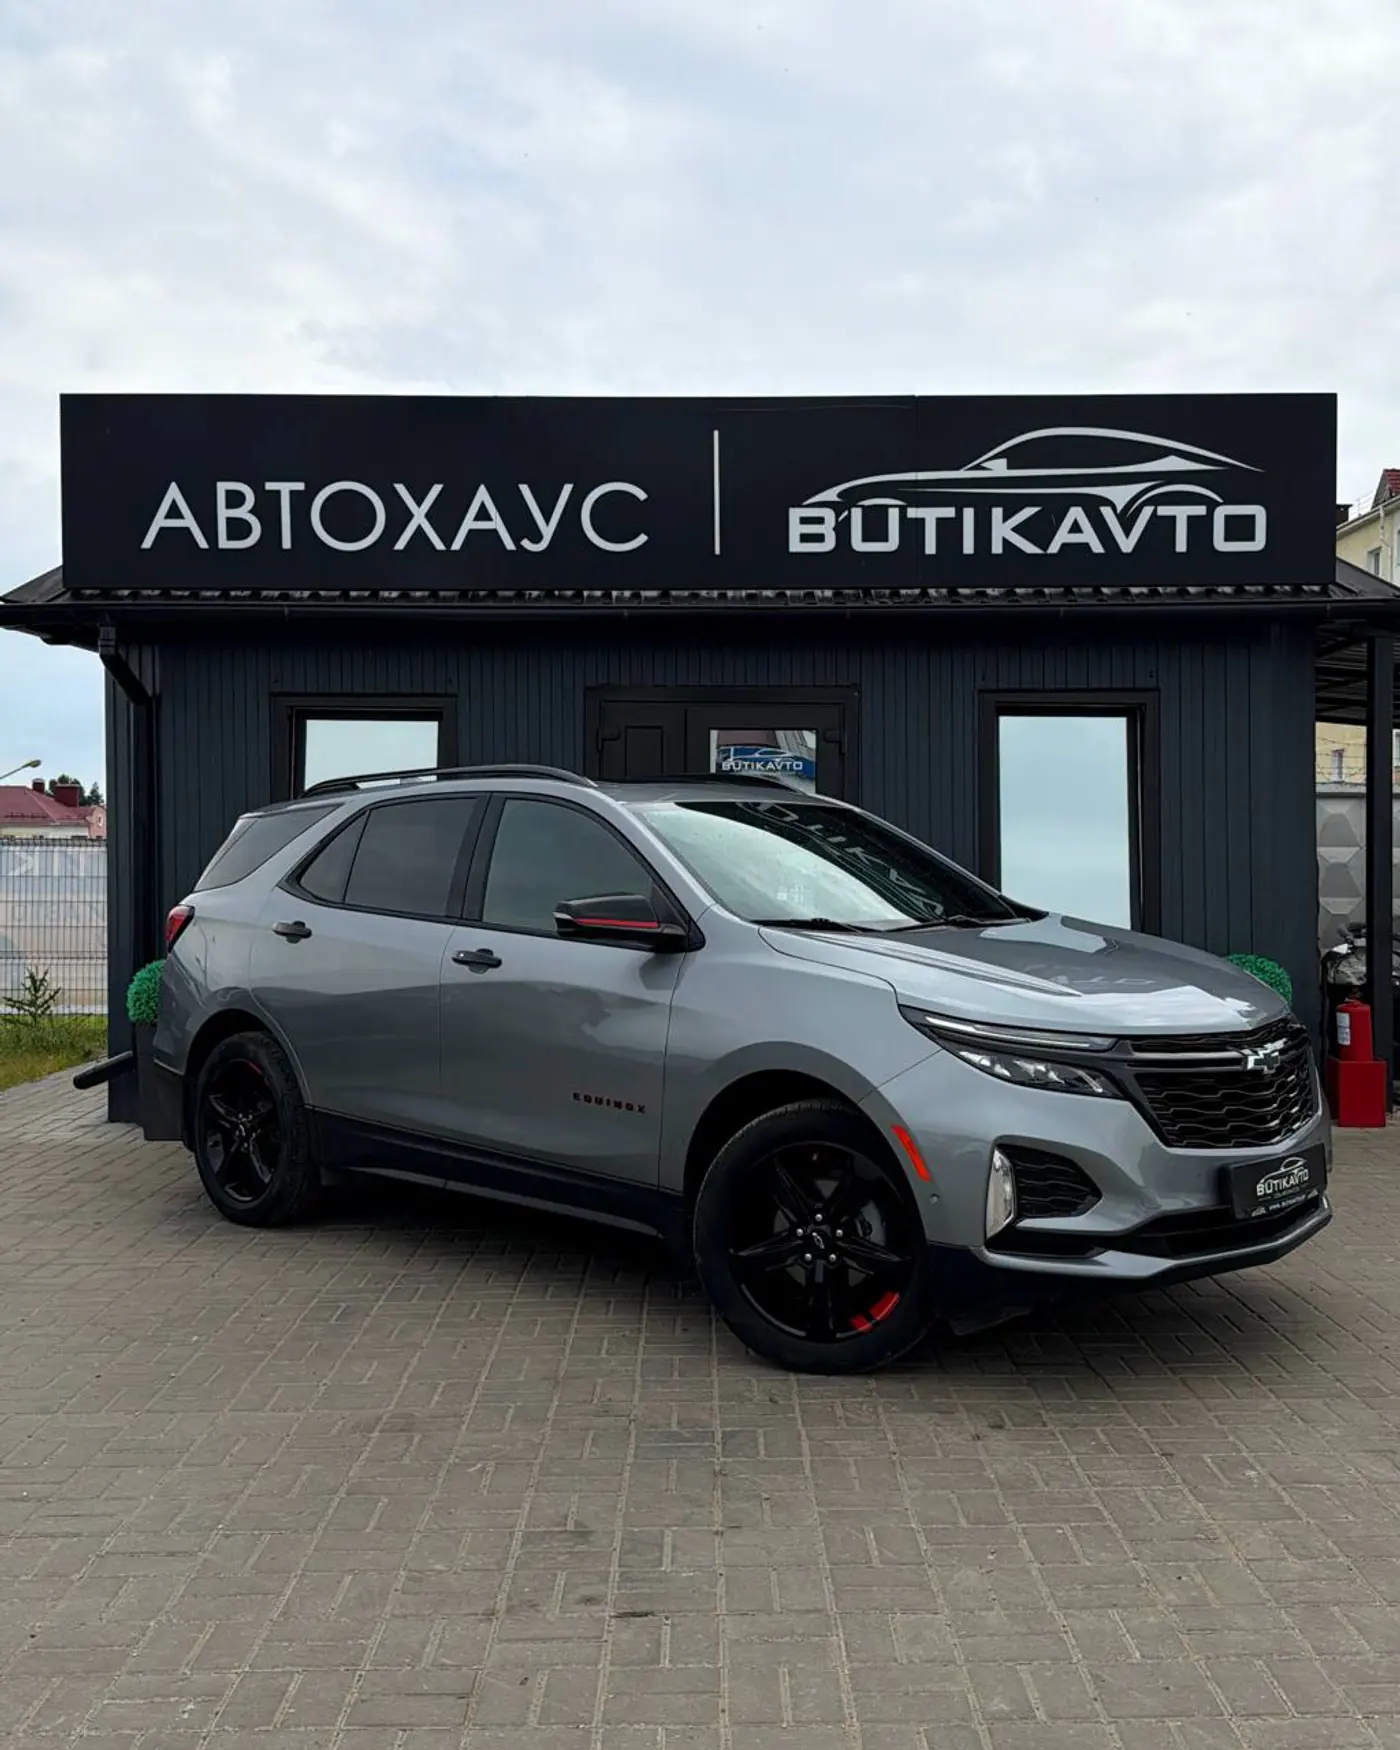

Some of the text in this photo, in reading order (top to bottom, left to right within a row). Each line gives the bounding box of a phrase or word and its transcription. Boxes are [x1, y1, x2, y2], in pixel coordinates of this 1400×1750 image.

[141, 481, 648, 551] АВТОХАУС
[789, 504, 1266, 554] BUTIKAVTO
[722, 761, 803, 771] BUTIKAVTO
[572, 1091, 646, 1114] EQUINOX
[1256, 1169, 1310, 1196] BUTIKAVTO
